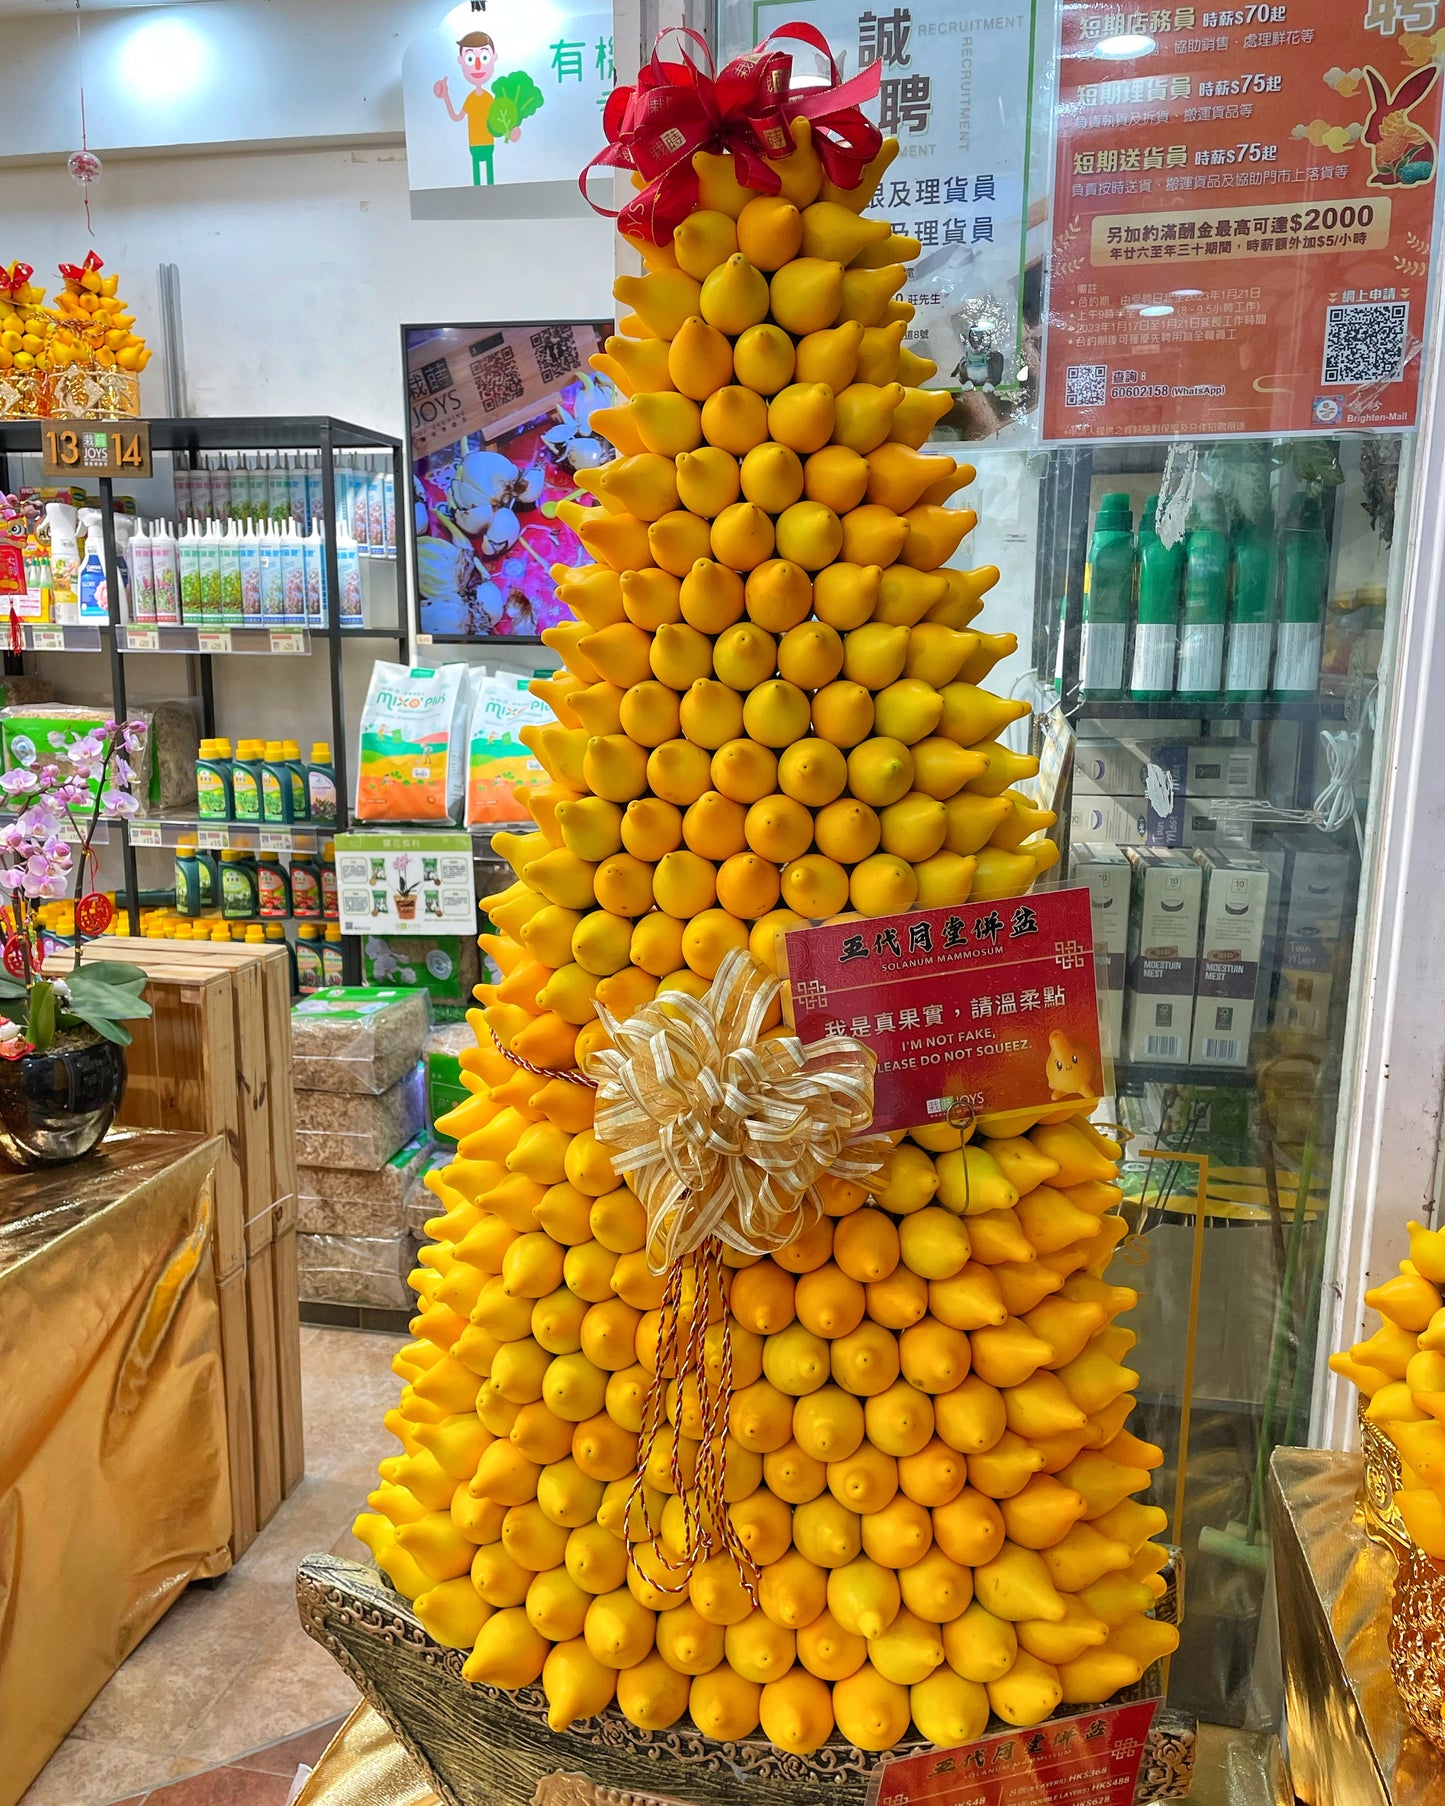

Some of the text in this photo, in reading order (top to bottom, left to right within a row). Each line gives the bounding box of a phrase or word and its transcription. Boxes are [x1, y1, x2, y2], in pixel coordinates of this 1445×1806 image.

[918, 15, 1024, 36] RECRUITMENT
[1079, 3, 1286, 40] 短期店務員 時薪$70起
[858, 8, 911, 68] 誠
[960, 36, 973, 151] RECRUITMENT
[1077, 73, 1282, 107] 短期理貨員 時薪$75起
[878, 74, 931, 134] 聘
[1073, 142, 1277, 179] 短期送貨員 時薪$75起
[1107, 204, 1375, 244] 另加約滿酬金最高可達$2000
[1342, 287, 1396, 303] 網上申請
[1111, 385, 1226, 398] 60602158 (WhatsApp)
[411, 390, 462, 428] JOYS
[1346, 411, 1408, 424] Brighten-Mall
[46, 431, 80, 465] 13
[83, 447, 108, 459] JOYS
[111, 433, 142, 466] 14
[424, 693, 446, 708] plus
[1169, 877, 1179, 885] 10
[1235, 880, 1245, 888] 10
[881, 945, 1004, 971] SOLANUM MAMMOSUM
[1144, 960, 1182, 971] MOESTUIN
[1206, 963, 1244, 974] MOESTUIN
[1143, 969, 1164, 978] MEST
[1205, 972, 1226, 981] MEST
[824, 985, 1067, 1039] 我是真果實，請溫柔點
[902, 1027, 997, 1052] I'M NOT FAKE,
[877, 1039, 1033, 1074] LEASE DO NOT SQUEEZ.
[956, 1091, 985, 1108] JOYS
[964, 1763, 1011, 1780] SOLANUM
[1092, 1775, 1131, 1791] HK$488
